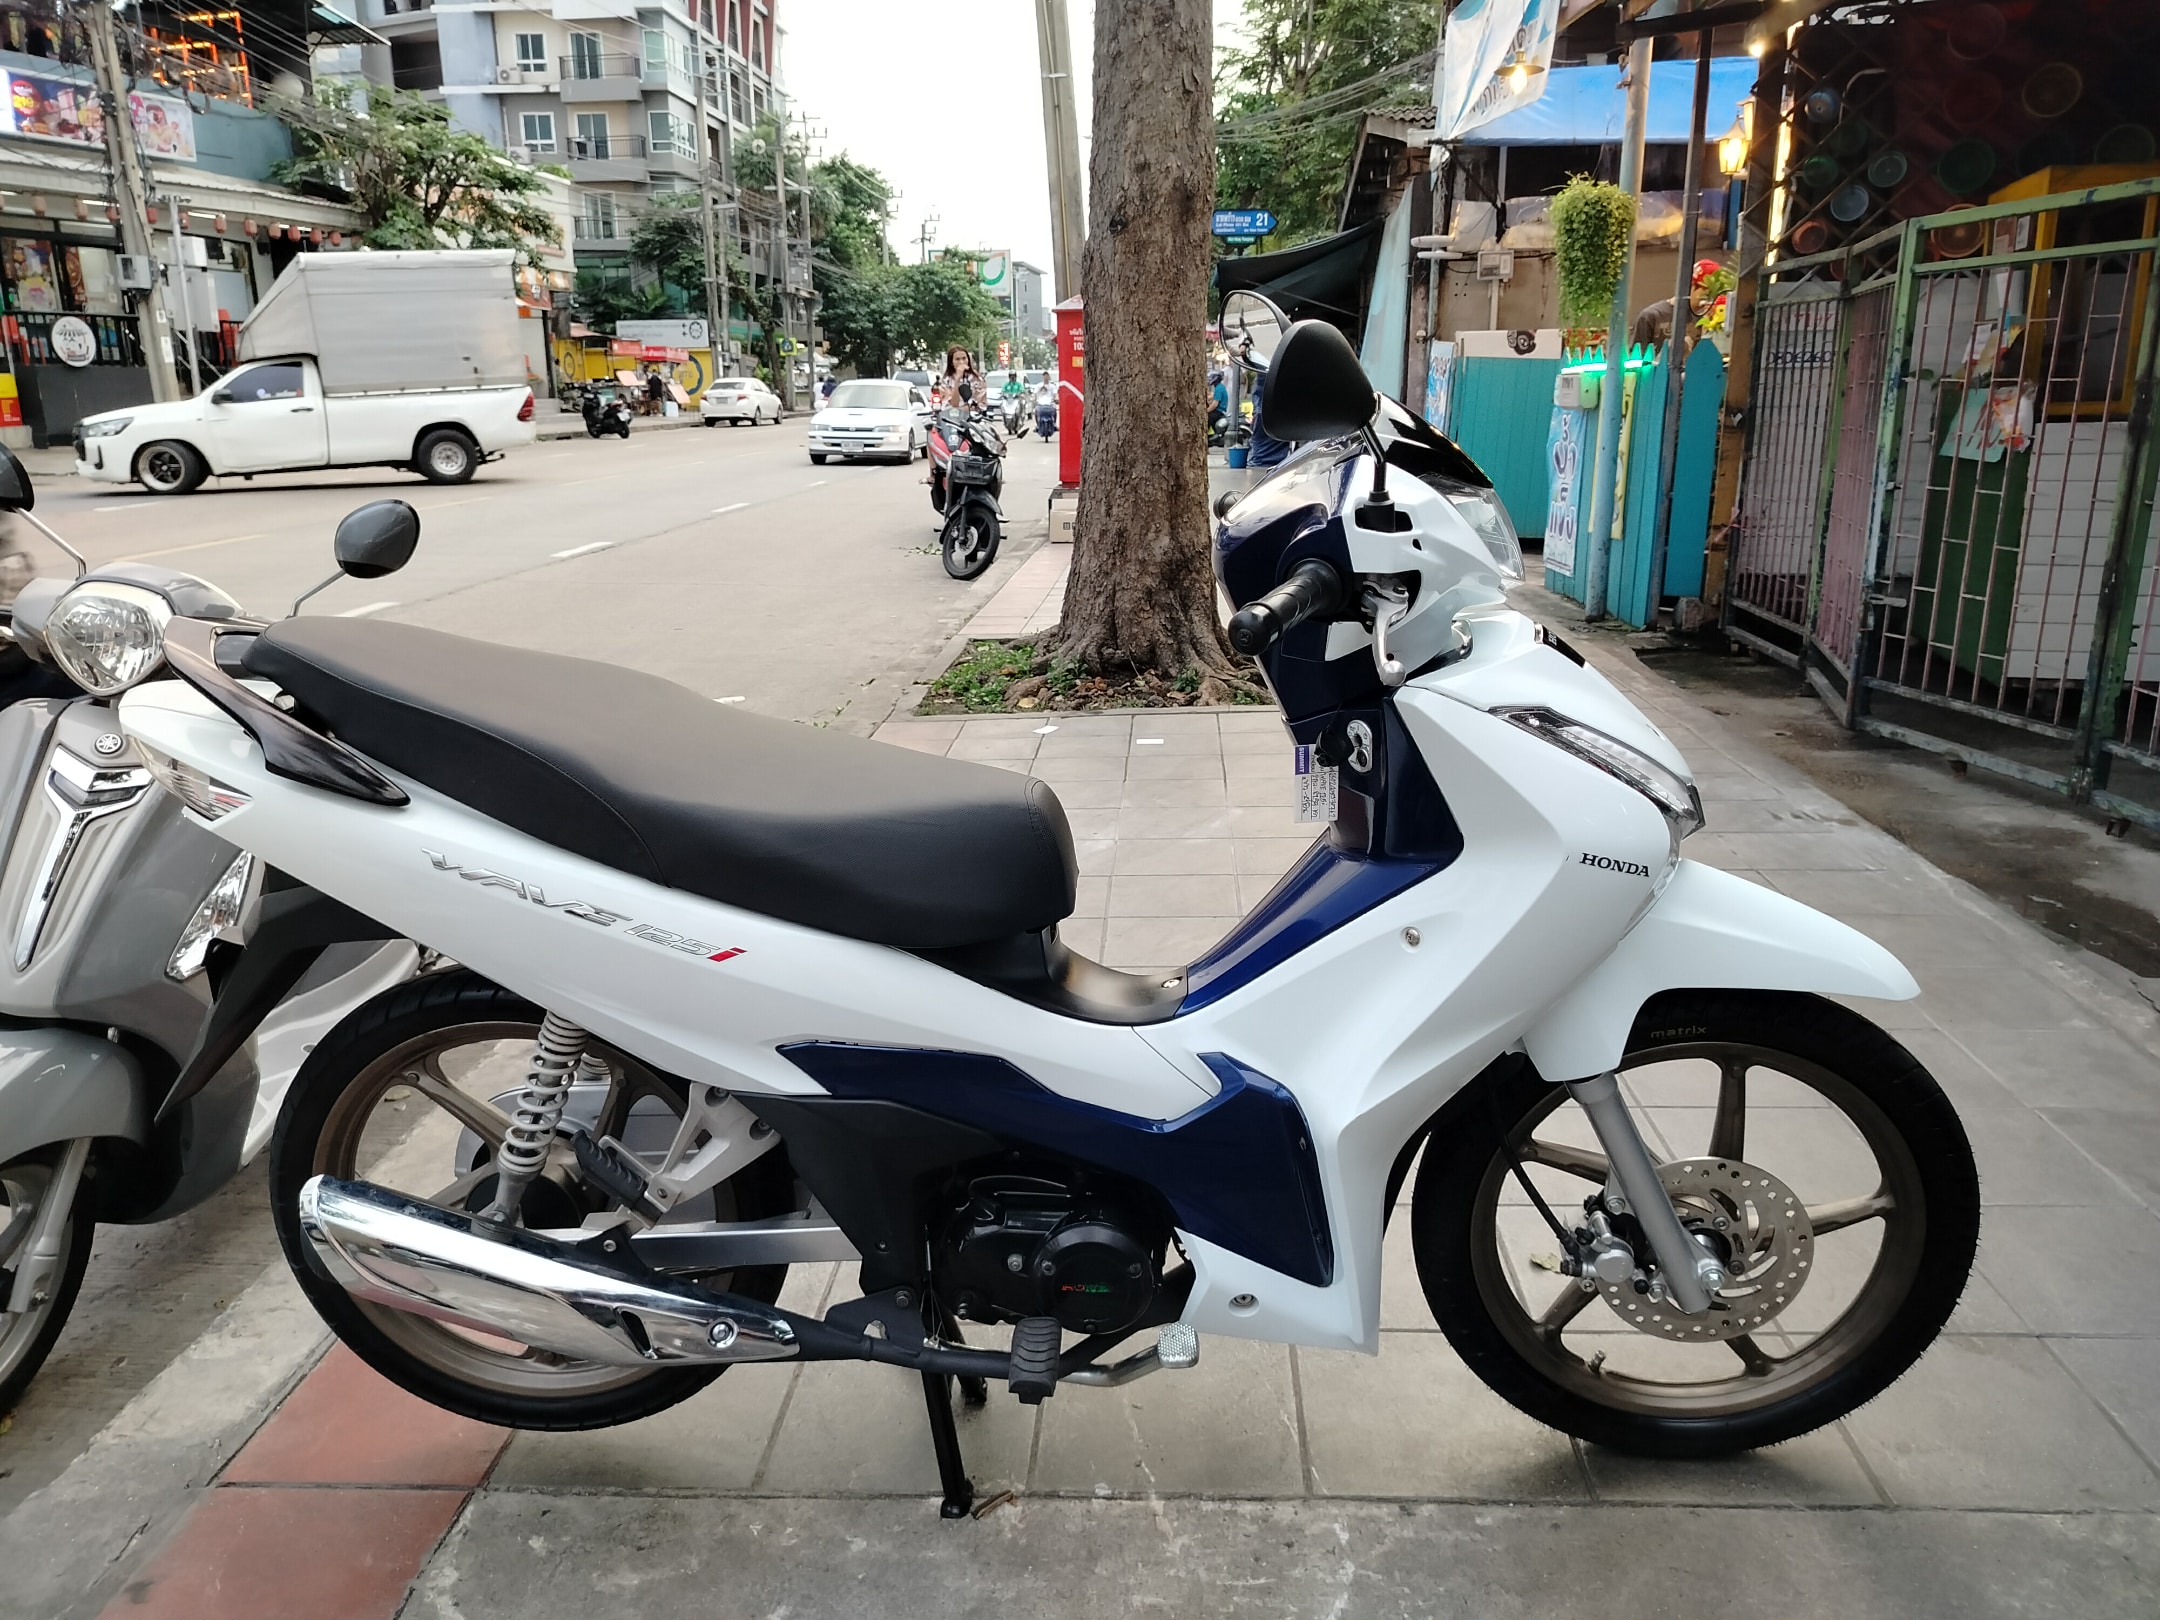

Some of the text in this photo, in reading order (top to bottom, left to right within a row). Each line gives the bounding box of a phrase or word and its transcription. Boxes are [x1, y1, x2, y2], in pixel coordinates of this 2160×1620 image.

[1256, 213, 1268, 226] 21
[1579, 852, 1650, 878] HONDA
[421, 848, 747, 962] WAVE 125i
[1650, 1025, 1707, 1039] matrix
